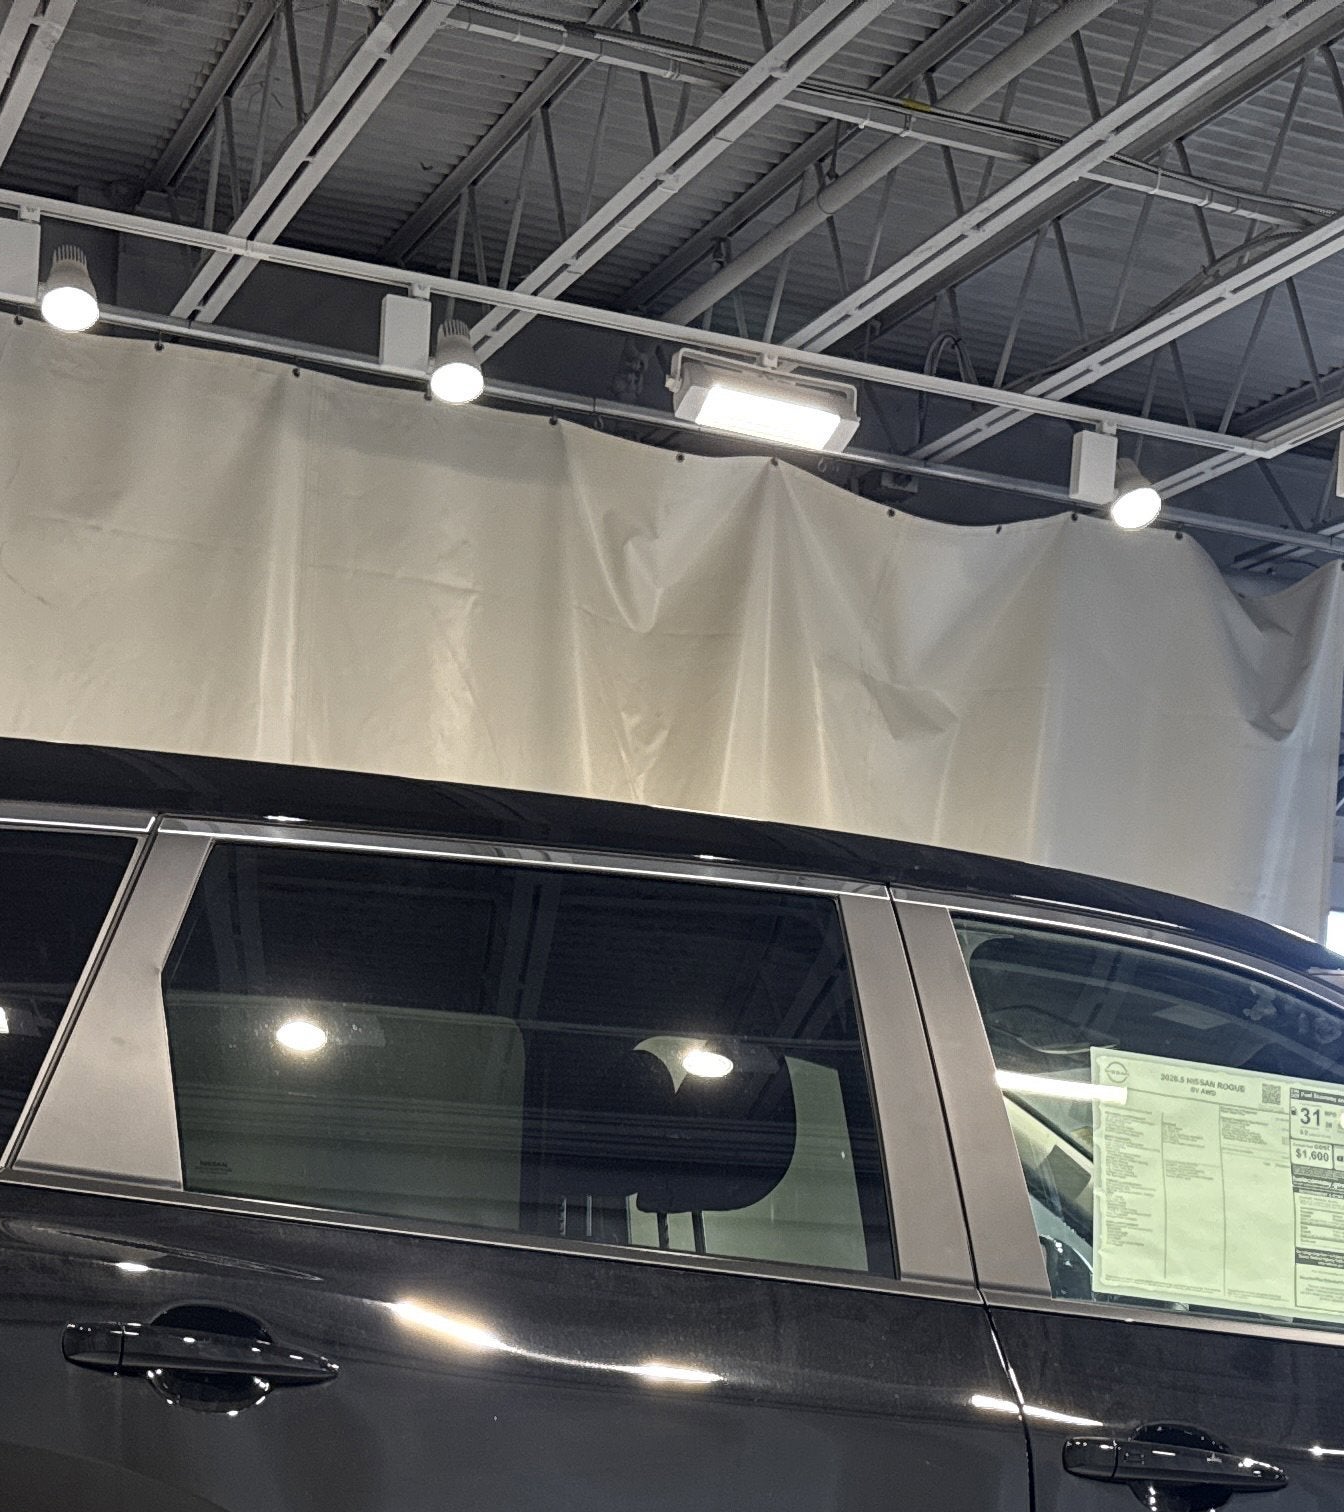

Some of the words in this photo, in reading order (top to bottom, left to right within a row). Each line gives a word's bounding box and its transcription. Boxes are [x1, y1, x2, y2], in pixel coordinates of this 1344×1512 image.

[1186, 1078, 1215, 1088] NISSAN
[1217, 1082, 1245, 1093] ROGUE
[1300, 1107, 1321, 1127] 31
[1296, 1148, 1329, 1162] $1,600
